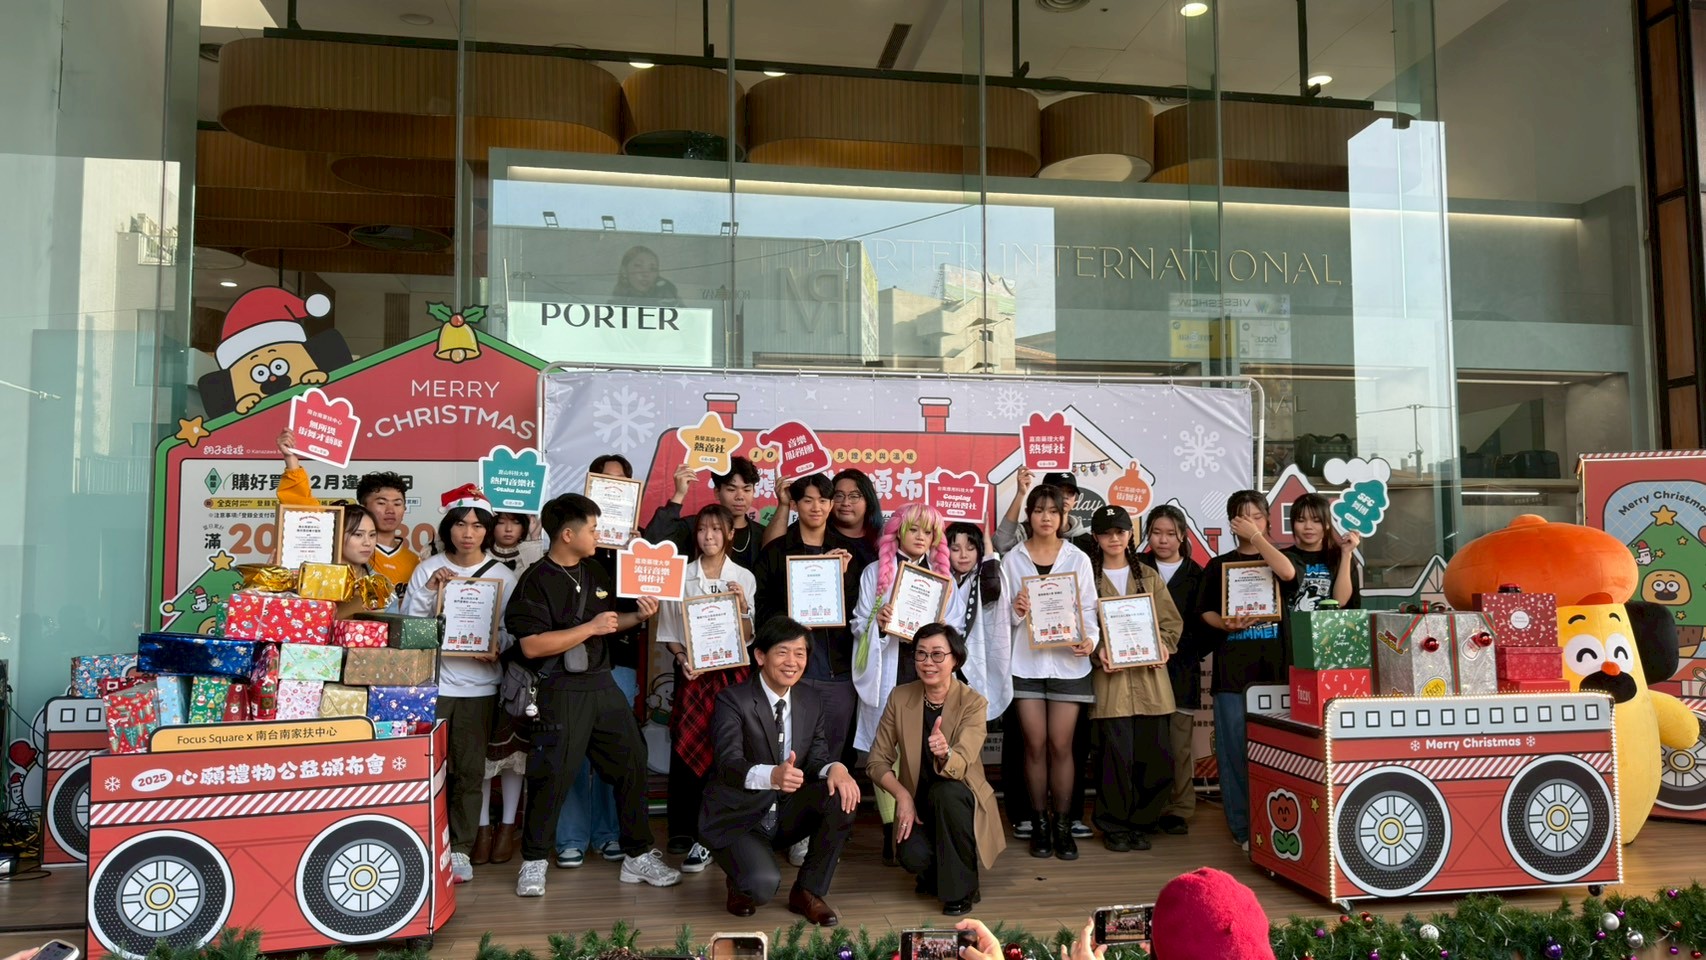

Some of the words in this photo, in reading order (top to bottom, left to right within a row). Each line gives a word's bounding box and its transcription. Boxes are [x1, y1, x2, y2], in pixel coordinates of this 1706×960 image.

[541, 302, 680, 331] PORTER
[411, 379, 500, 398] MERRY
[374, 405, 536, 440] CHRISTMAS
[693, 442, 726, 454] 熱音社
[787, 434, 807, 448] 音樂
[1029, 443, 1066, 454] 熱舞社
[785, 444, 815, 461] 服務團
[1618, 494, 1650, 516] Merry
[634, 565, 670, 576] 流行音樂
[177, 734, 207, 745] Focus
[209, 732, 244, 745] Square
[256, 727, 338, 742] 南台南家扶中心
[1425, 738, 1460, 751] Merry
[1463, 737, 1522, 749] Christmas
[137, 774, 168, 788] 2025
[176, 753, 387, 786] 心願禮物公益頒布會
